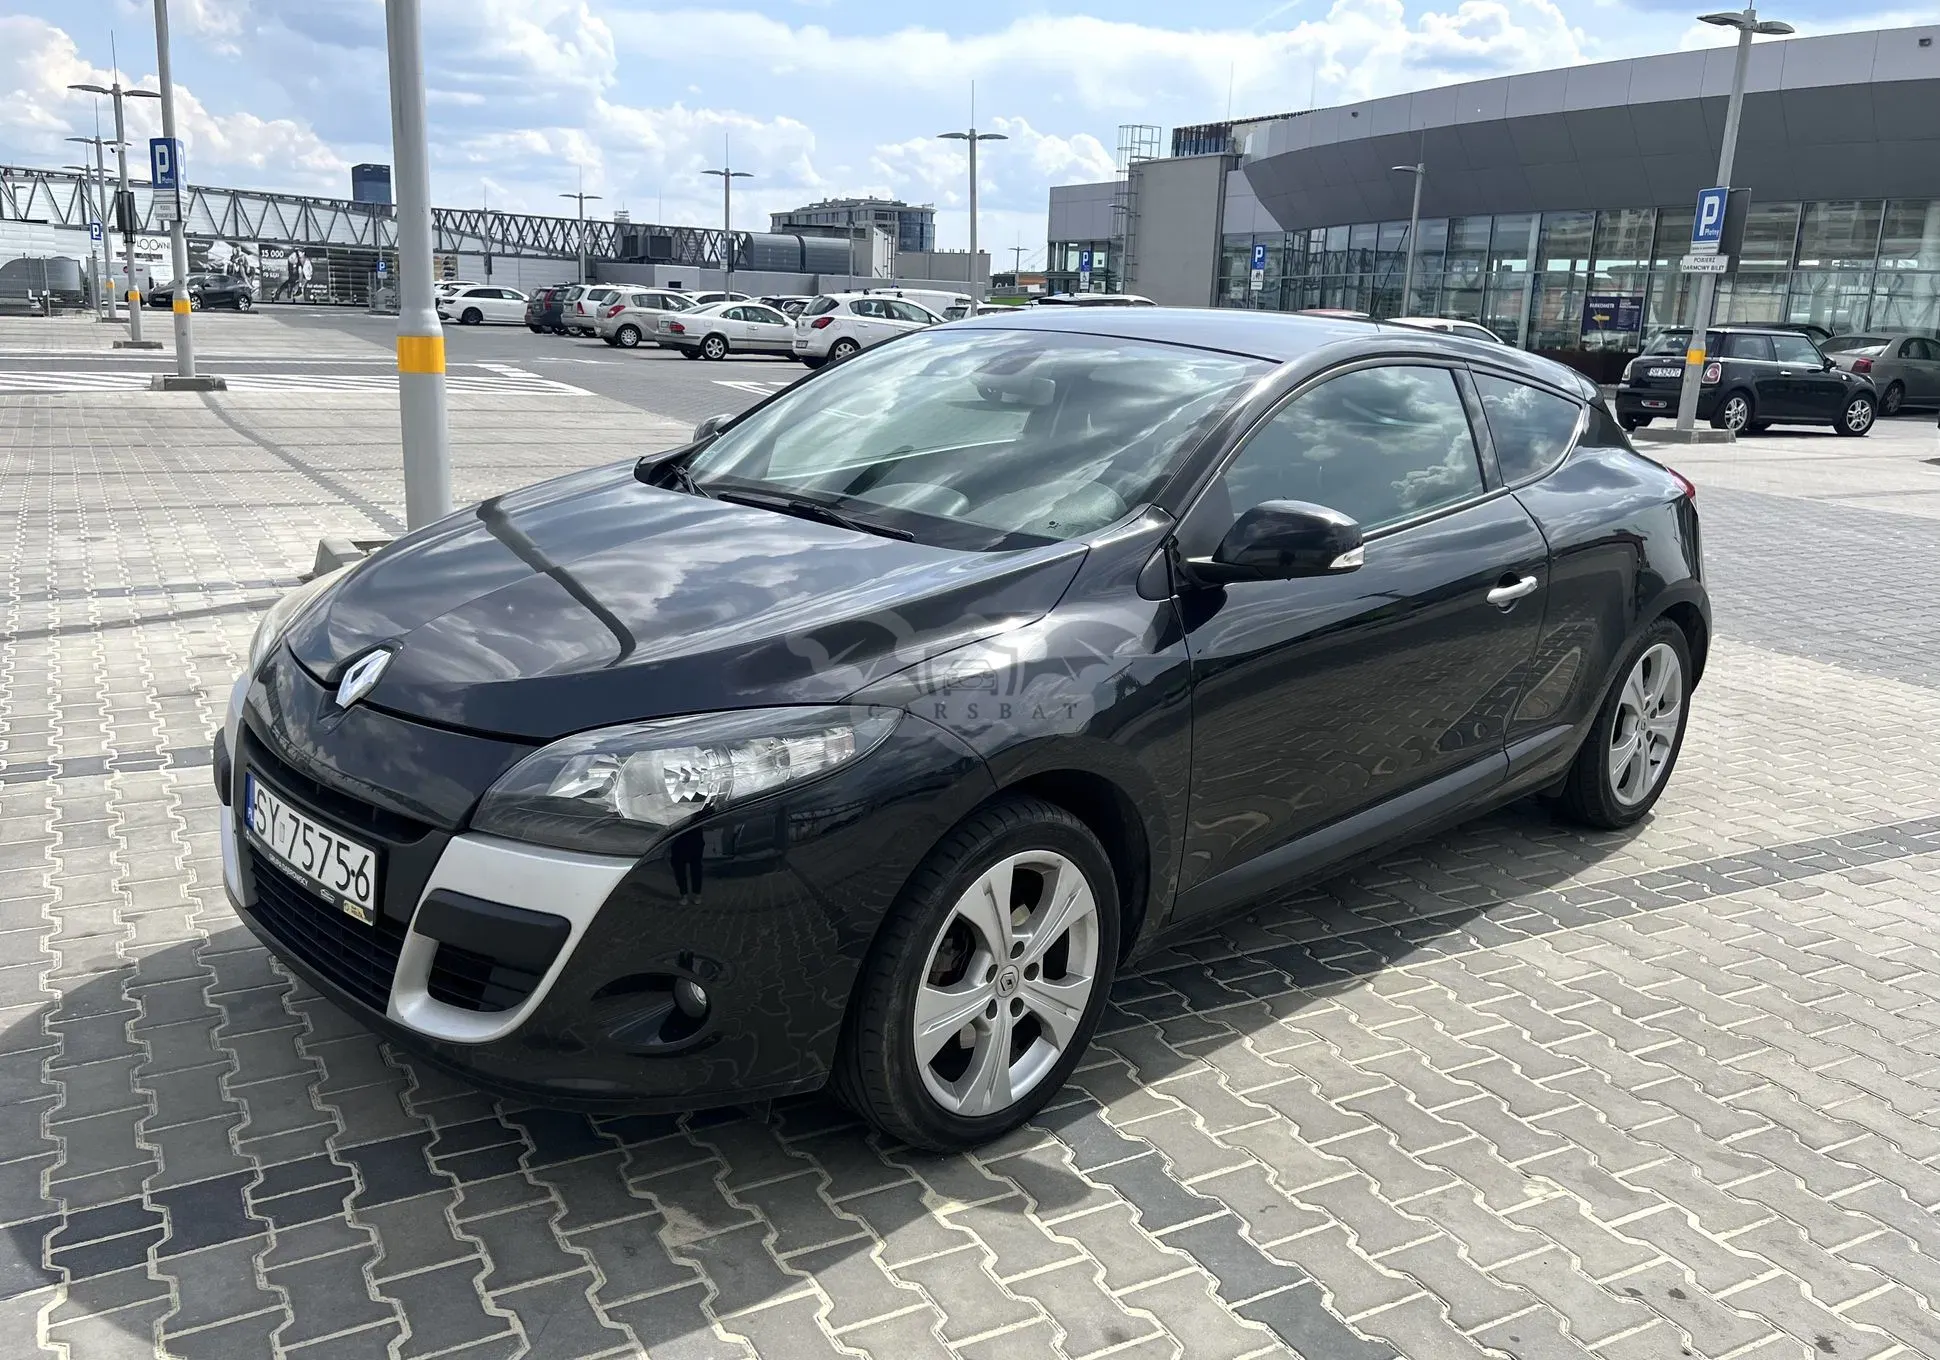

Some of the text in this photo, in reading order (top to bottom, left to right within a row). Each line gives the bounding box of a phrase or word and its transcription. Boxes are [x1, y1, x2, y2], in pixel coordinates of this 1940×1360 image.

[155, 144, 170, 184] P
[1699, 196, 1720, 237] P
[92, 224, 101, 237] P
[261, 249, 284, 258] 15 000
[1082, 251, 1088, 266] P
[1254, 246, 1263, 263] P
[379, 261, 386, 271] P
[257, 788, 370, 902] SY 75756
